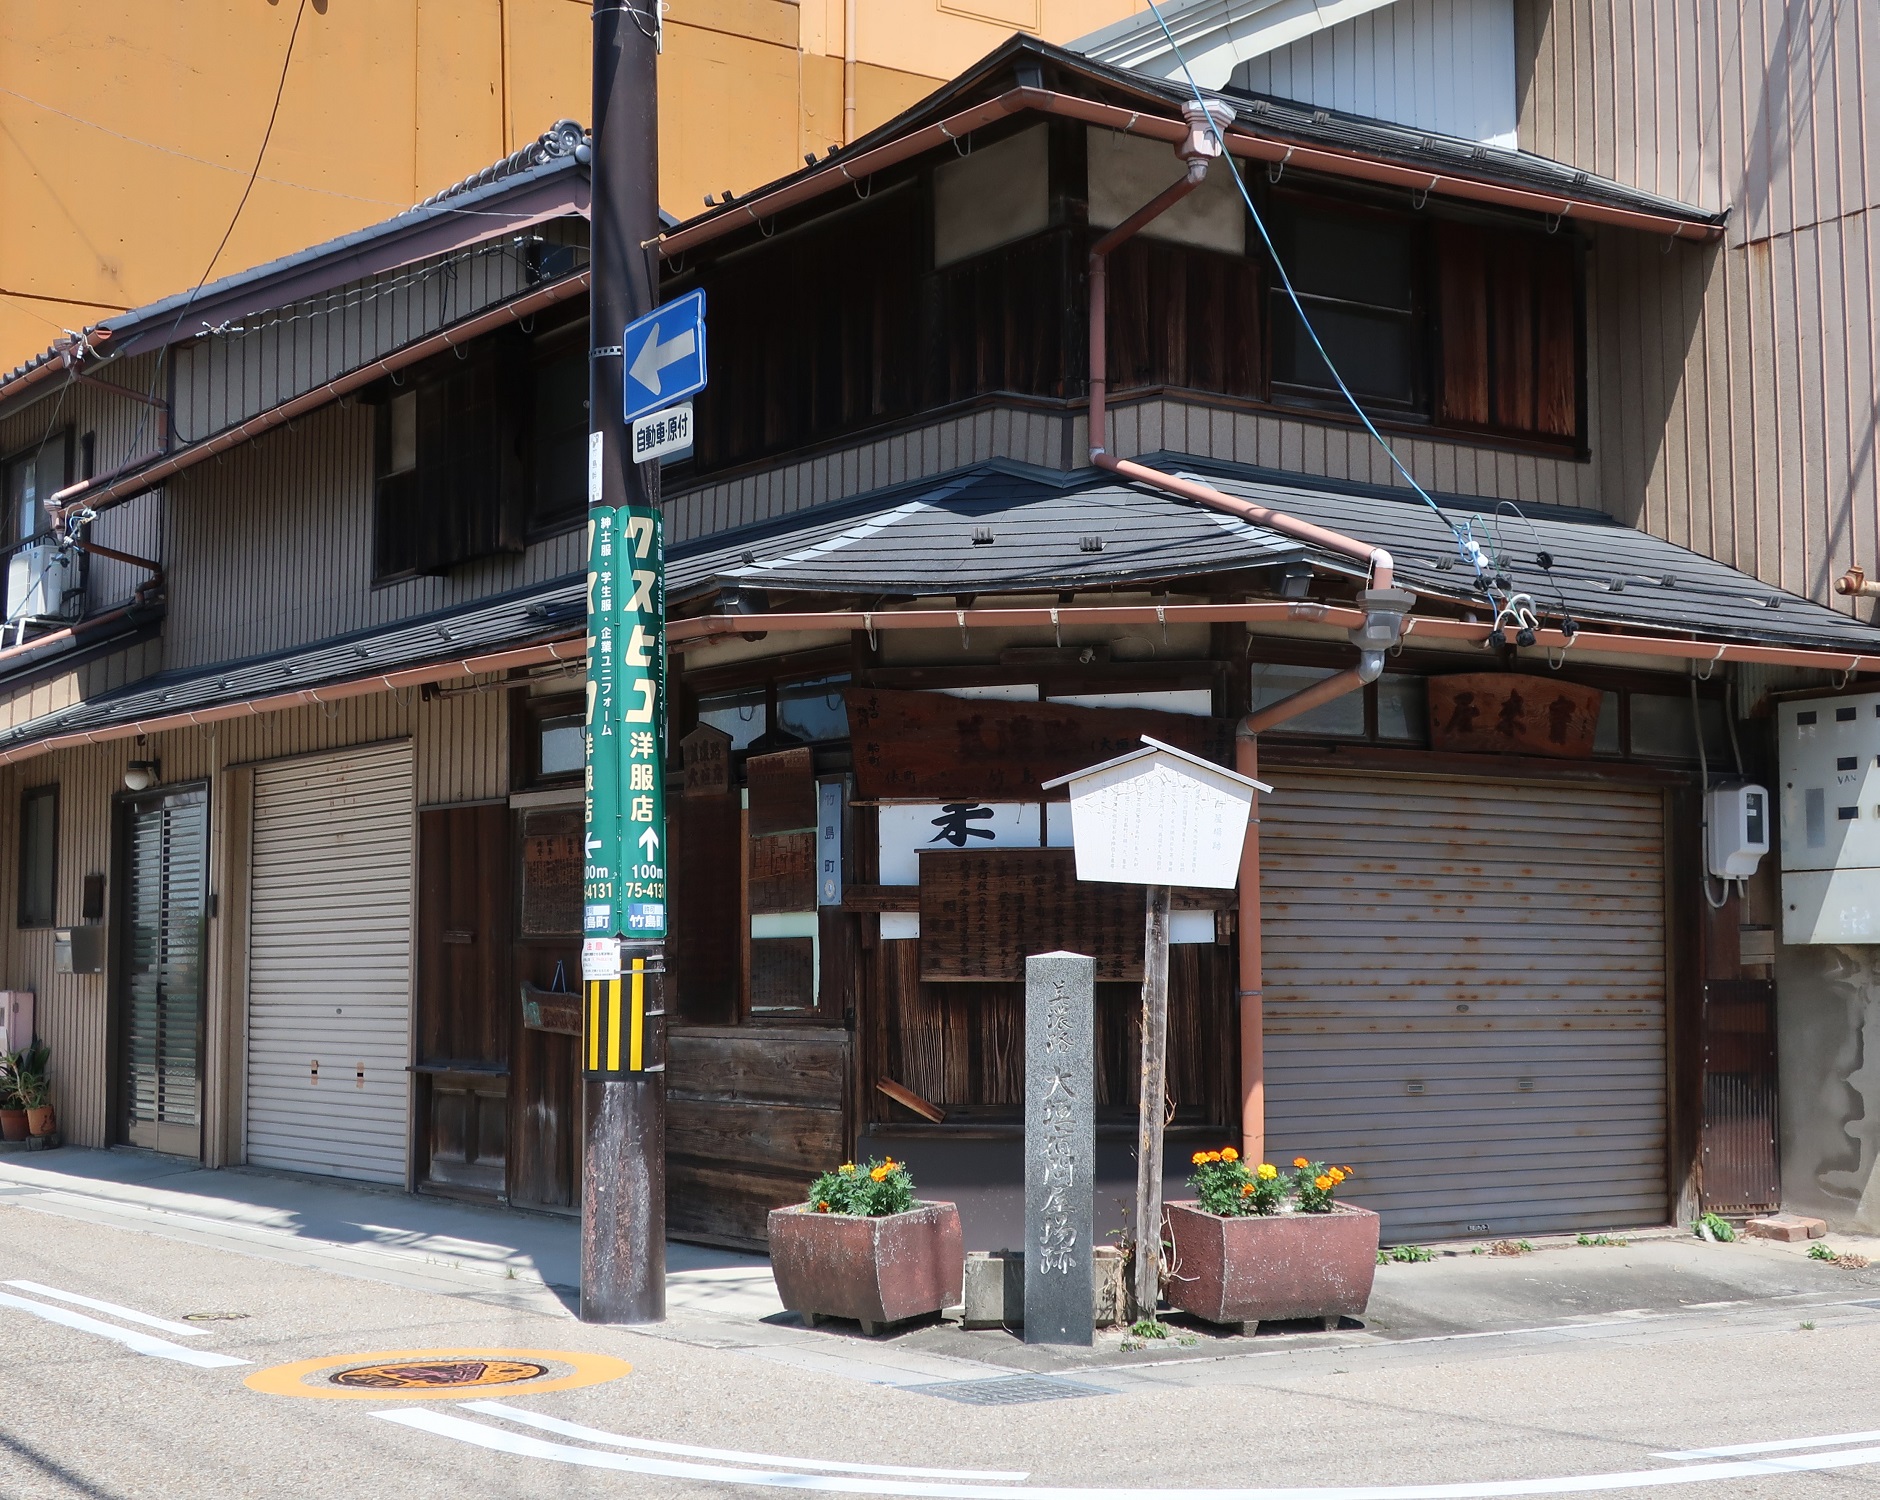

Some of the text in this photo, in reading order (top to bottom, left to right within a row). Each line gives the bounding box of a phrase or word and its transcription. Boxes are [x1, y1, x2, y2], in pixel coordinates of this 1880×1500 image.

[600, 517, 612, 736] 紳士服・学生服・企業ユニフォーム
[1836, 774, 1857, 785] VAN
[824, 793, 835, 873] 竹島町
[631, 864, 664, 879] 100m
[584, 915, 610, 929] 島町
[1045, 979, 1075, 1054] 美濃路
